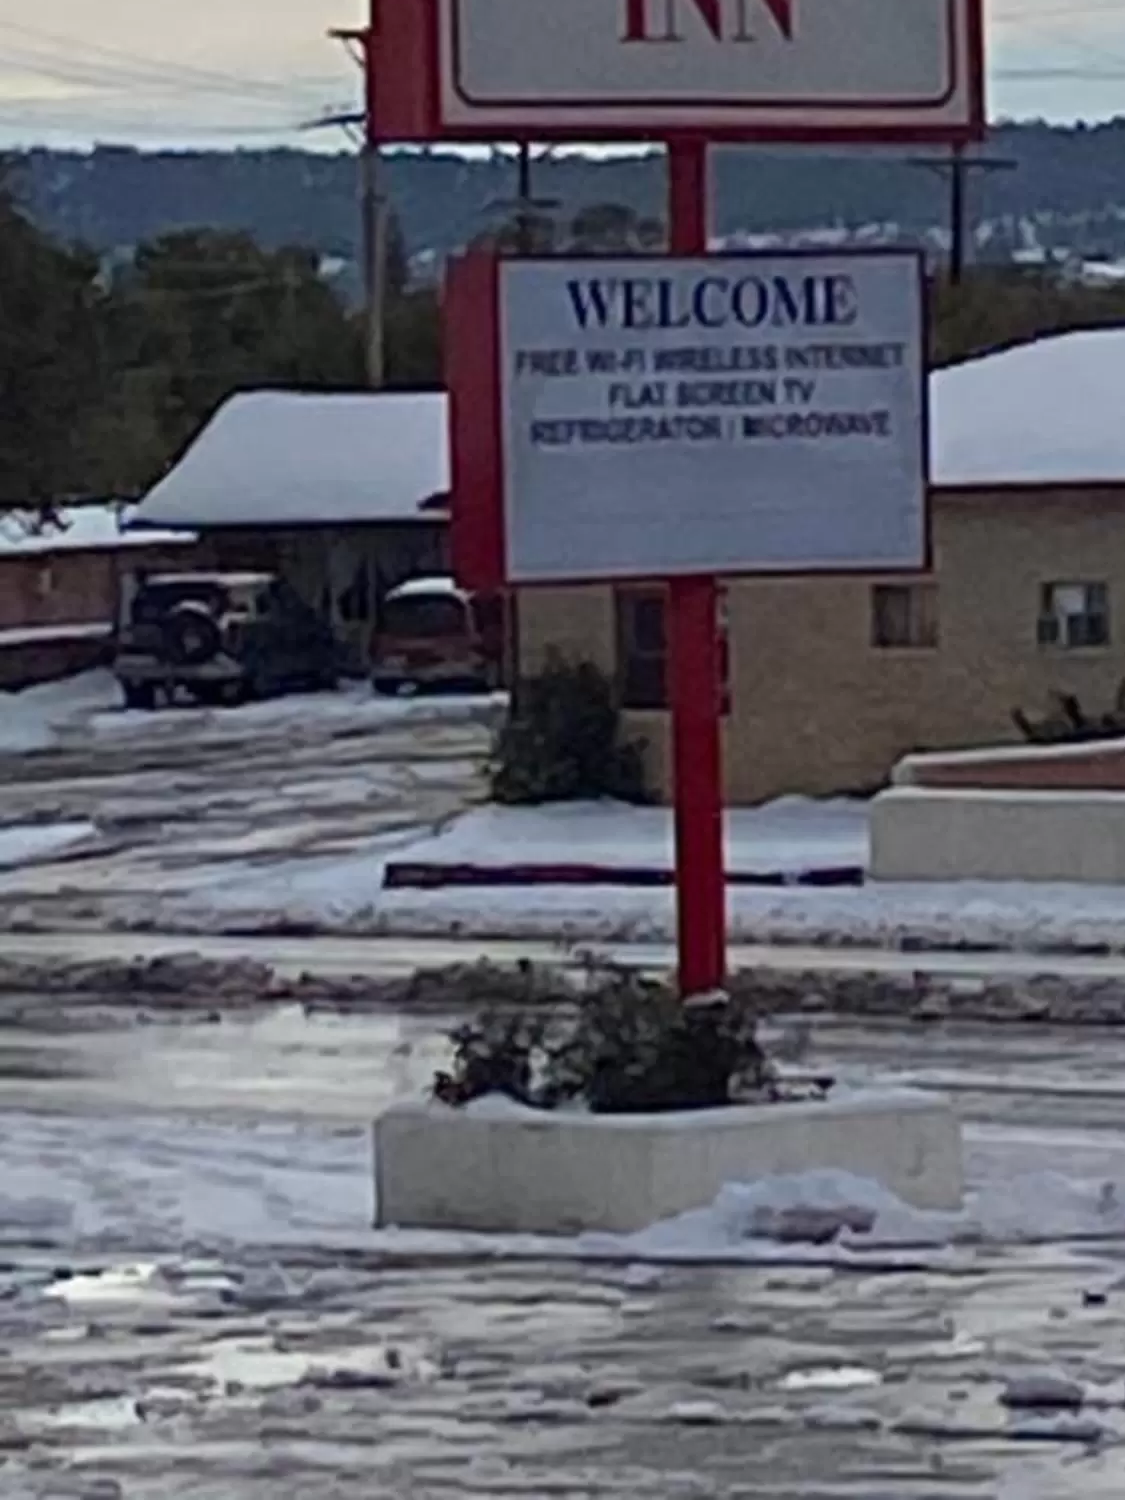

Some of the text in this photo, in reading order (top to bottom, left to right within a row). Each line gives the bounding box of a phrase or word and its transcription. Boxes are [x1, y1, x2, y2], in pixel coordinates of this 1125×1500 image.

[566, 275, 858, 329] WELCOME
[516, 342, 907, 376] FREE WI-FI WIRELESS INTERNET
[609, 378, 817, 408] FLAT SCREEN TV
[531, 418, 722, 444] REFRIGERATOR
[743, 412, 892, 439] MICROWAVE
